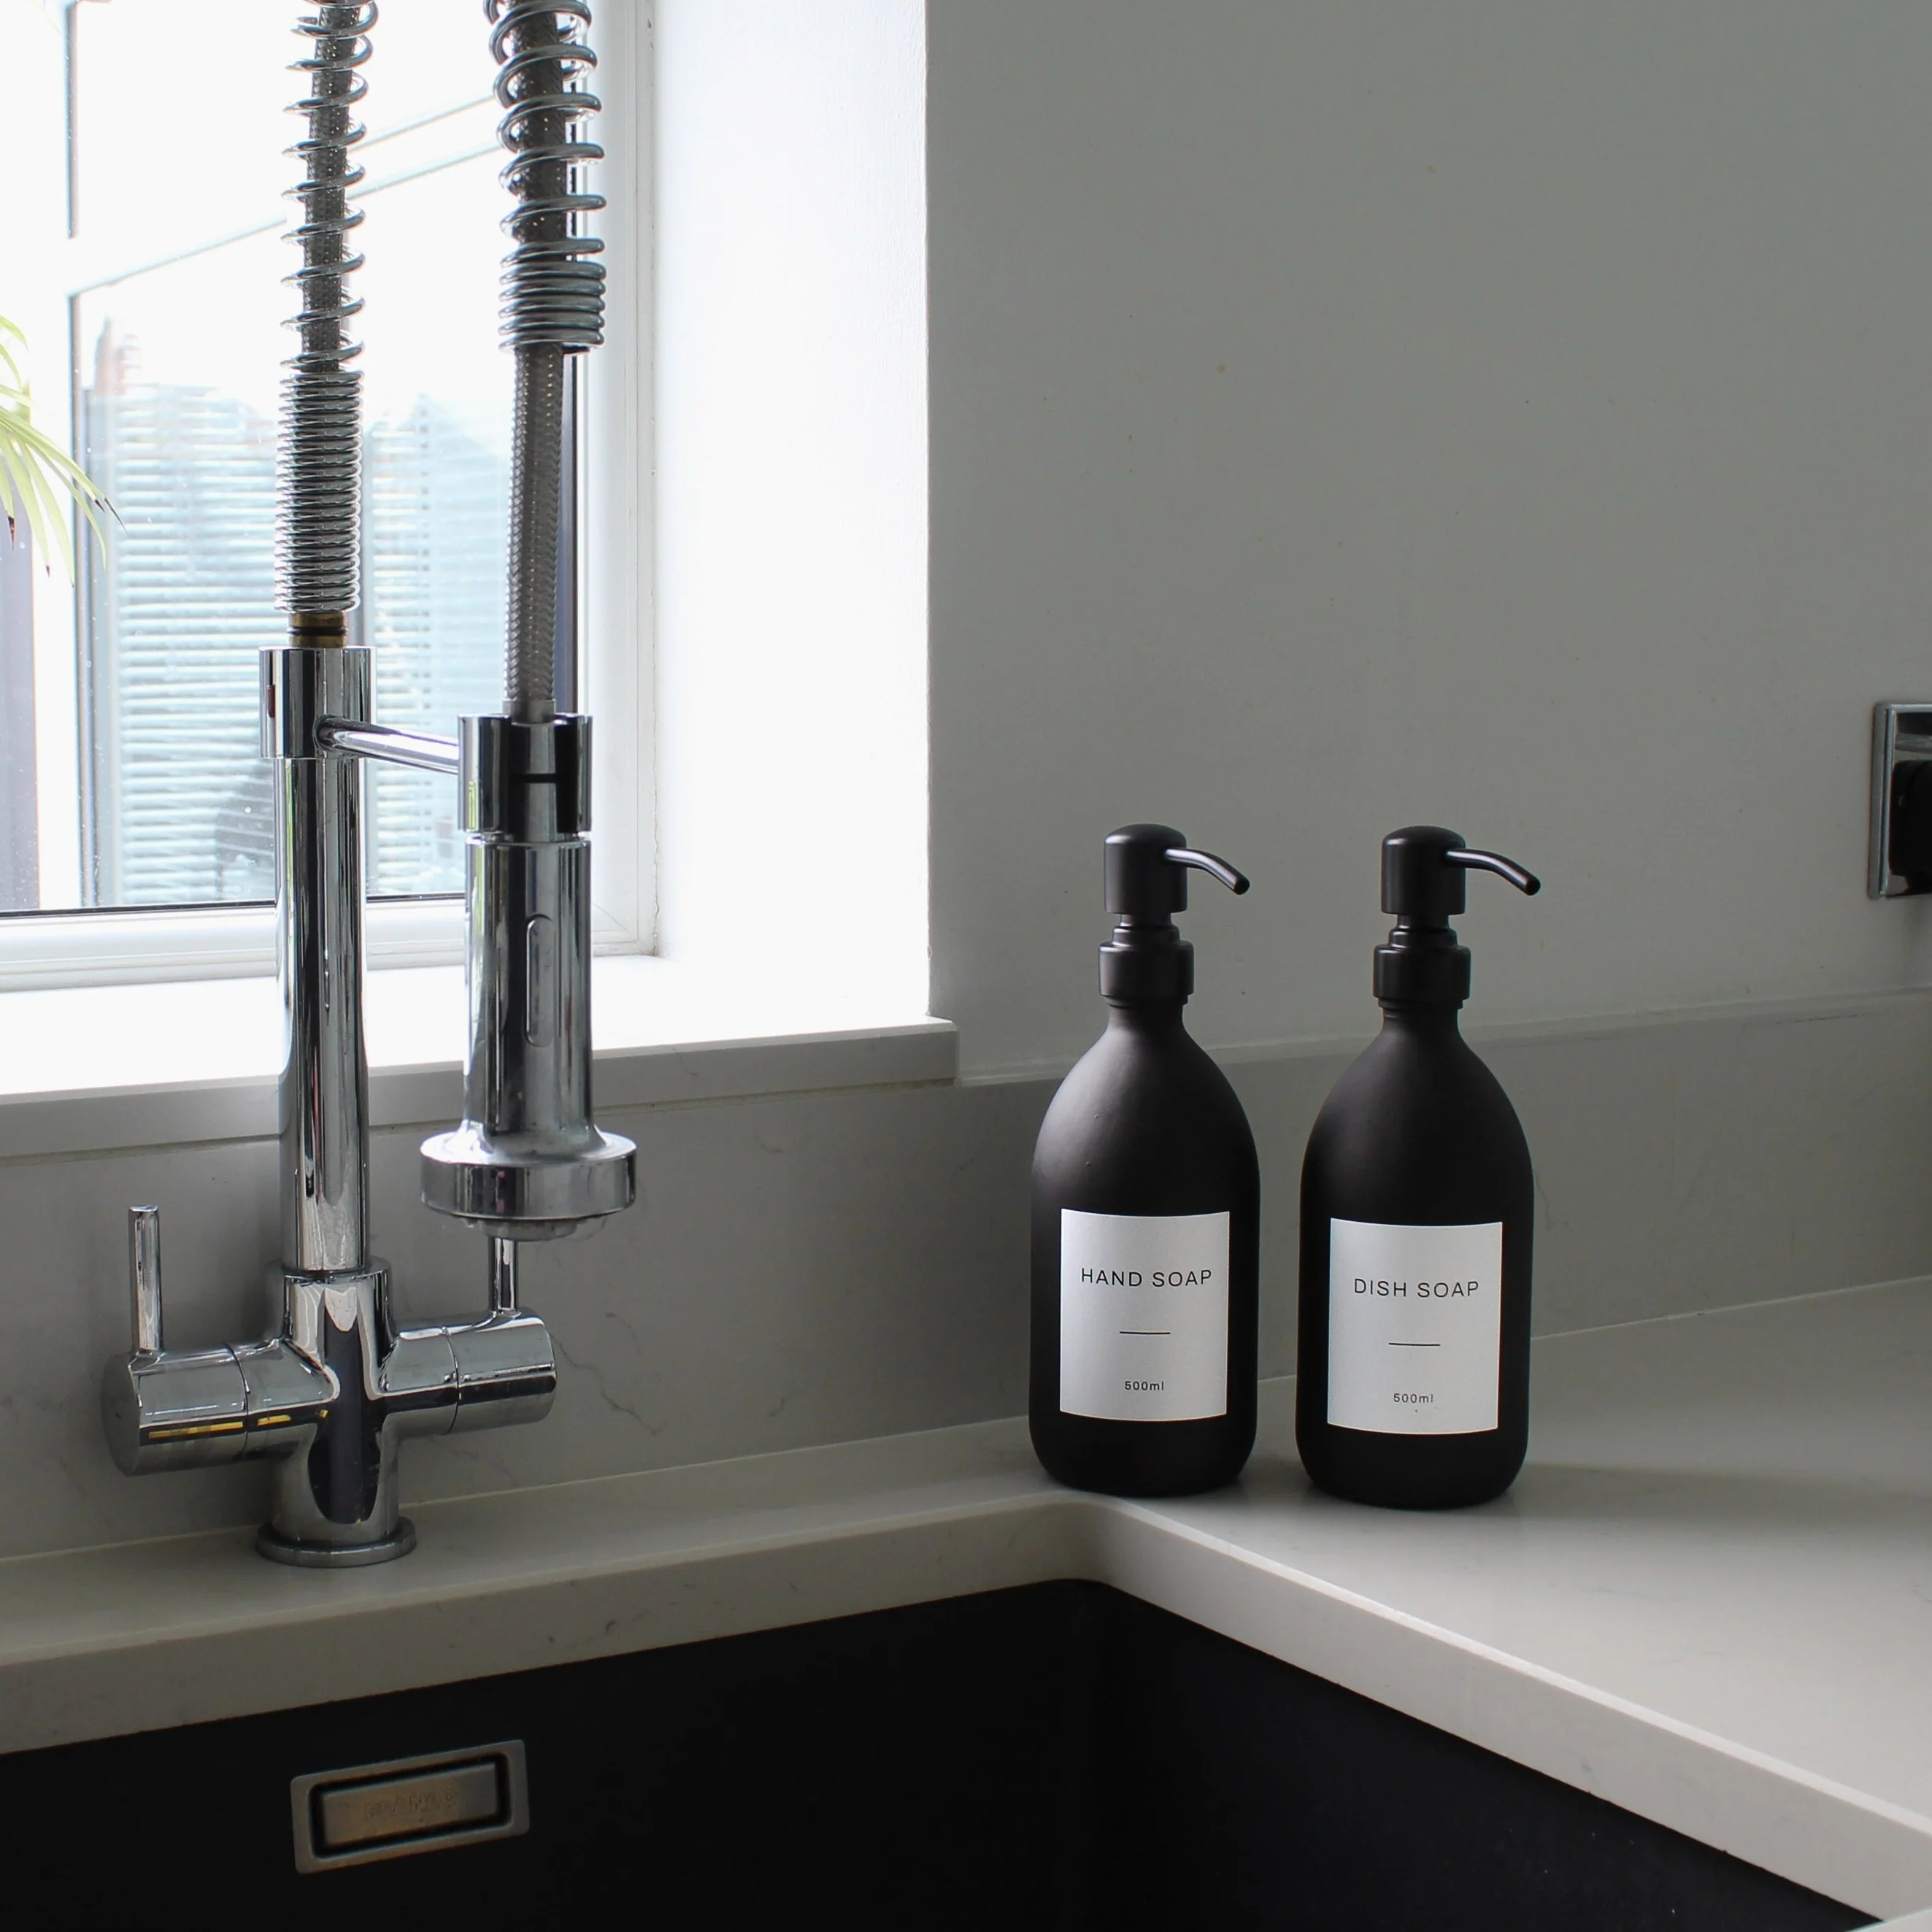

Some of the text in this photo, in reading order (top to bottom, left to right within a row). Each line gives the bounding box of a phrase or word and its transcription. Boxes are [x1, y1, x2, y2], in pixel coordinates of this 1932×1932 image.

[1081, 1268, 1212, 1288] HAND SOAP
[1354, 1278, 1479, 1298] DISH SOAP
[1124, 1380, 1165, 1391] 500ml
[1393, 1393, 1434, 1404] 500ml
